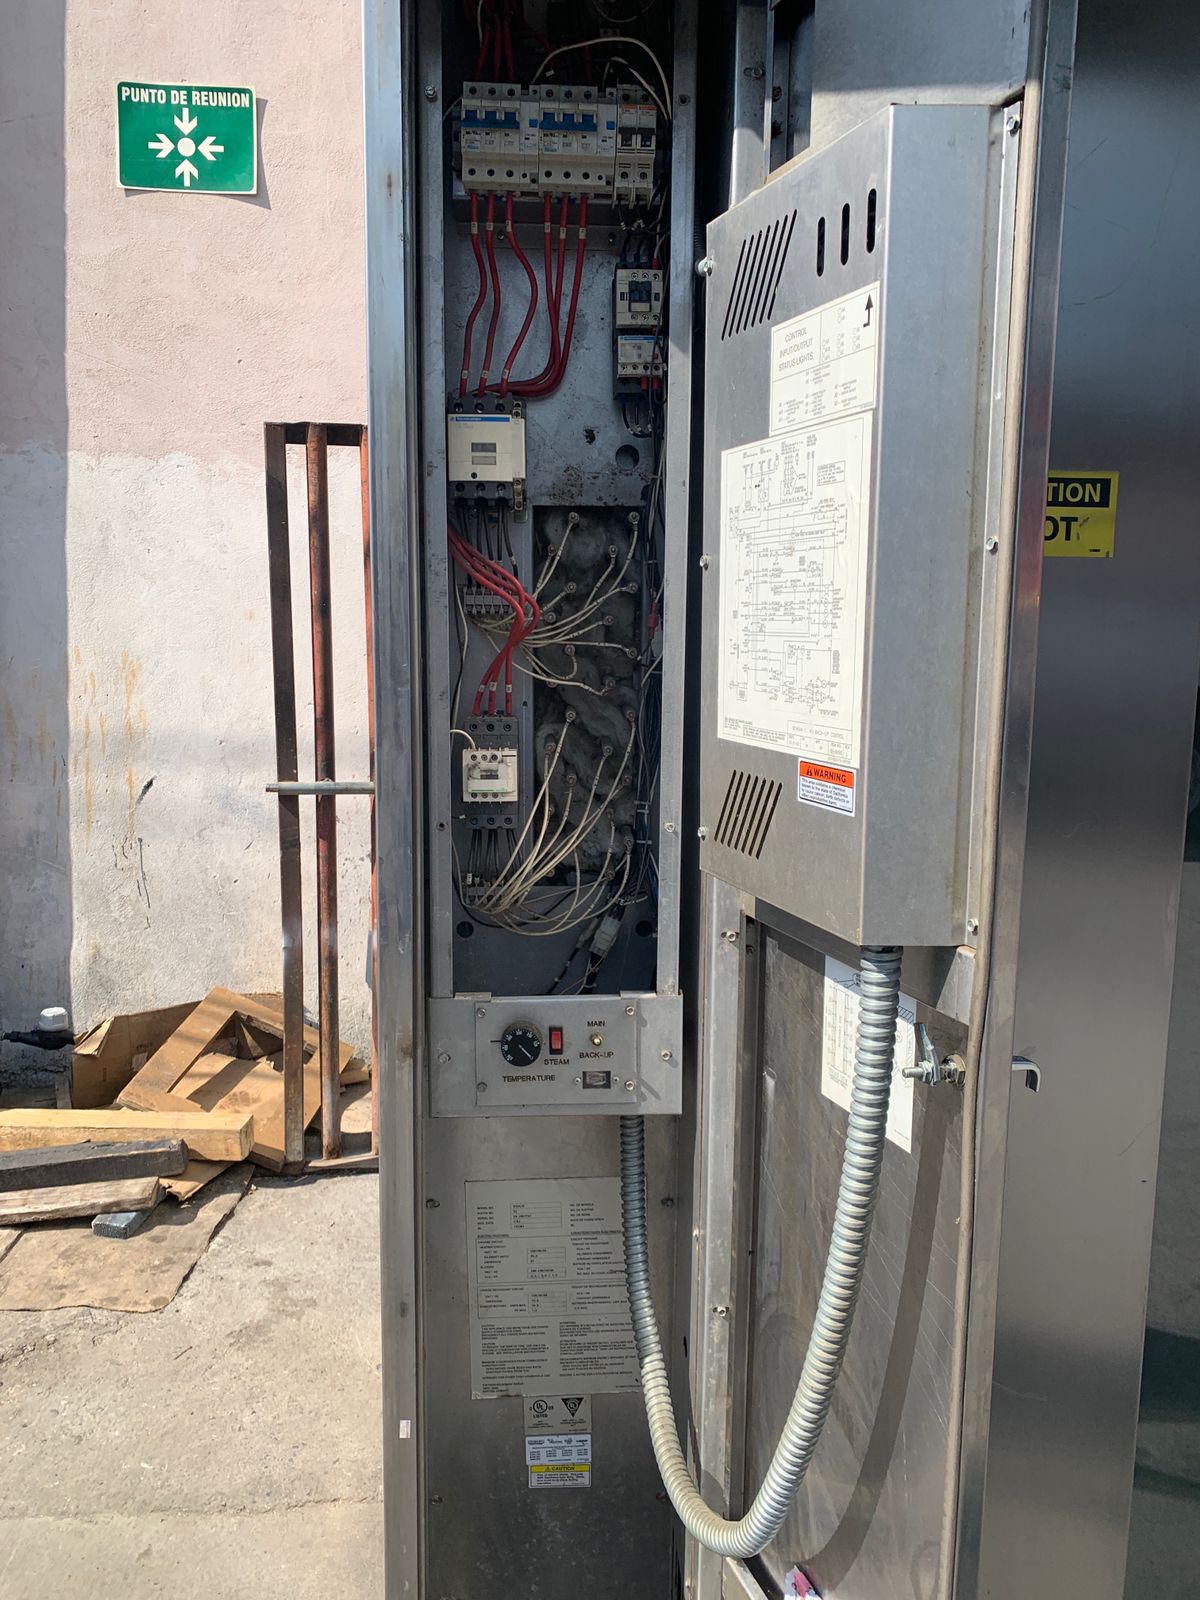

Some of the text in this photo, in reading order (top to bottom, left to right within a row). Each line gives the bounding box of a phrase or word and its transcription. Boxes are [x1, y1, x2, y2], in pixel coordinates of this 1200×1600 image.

[121, 86, 250, 108] PUNTO DE REUNION
[785, 327, 807, 343] CONTROL
[778, 352, 814, 372] STATUS LIGHTS
[813, 768, 846, 783] WARNING
[587, 1020, 606, 1028] MAIN
[579, 1051, 614, 1059] BACK-UP
[543, 1058, 570, 1066] STEAM
[502, 1074, 556, 1083] TEMPERATURE
